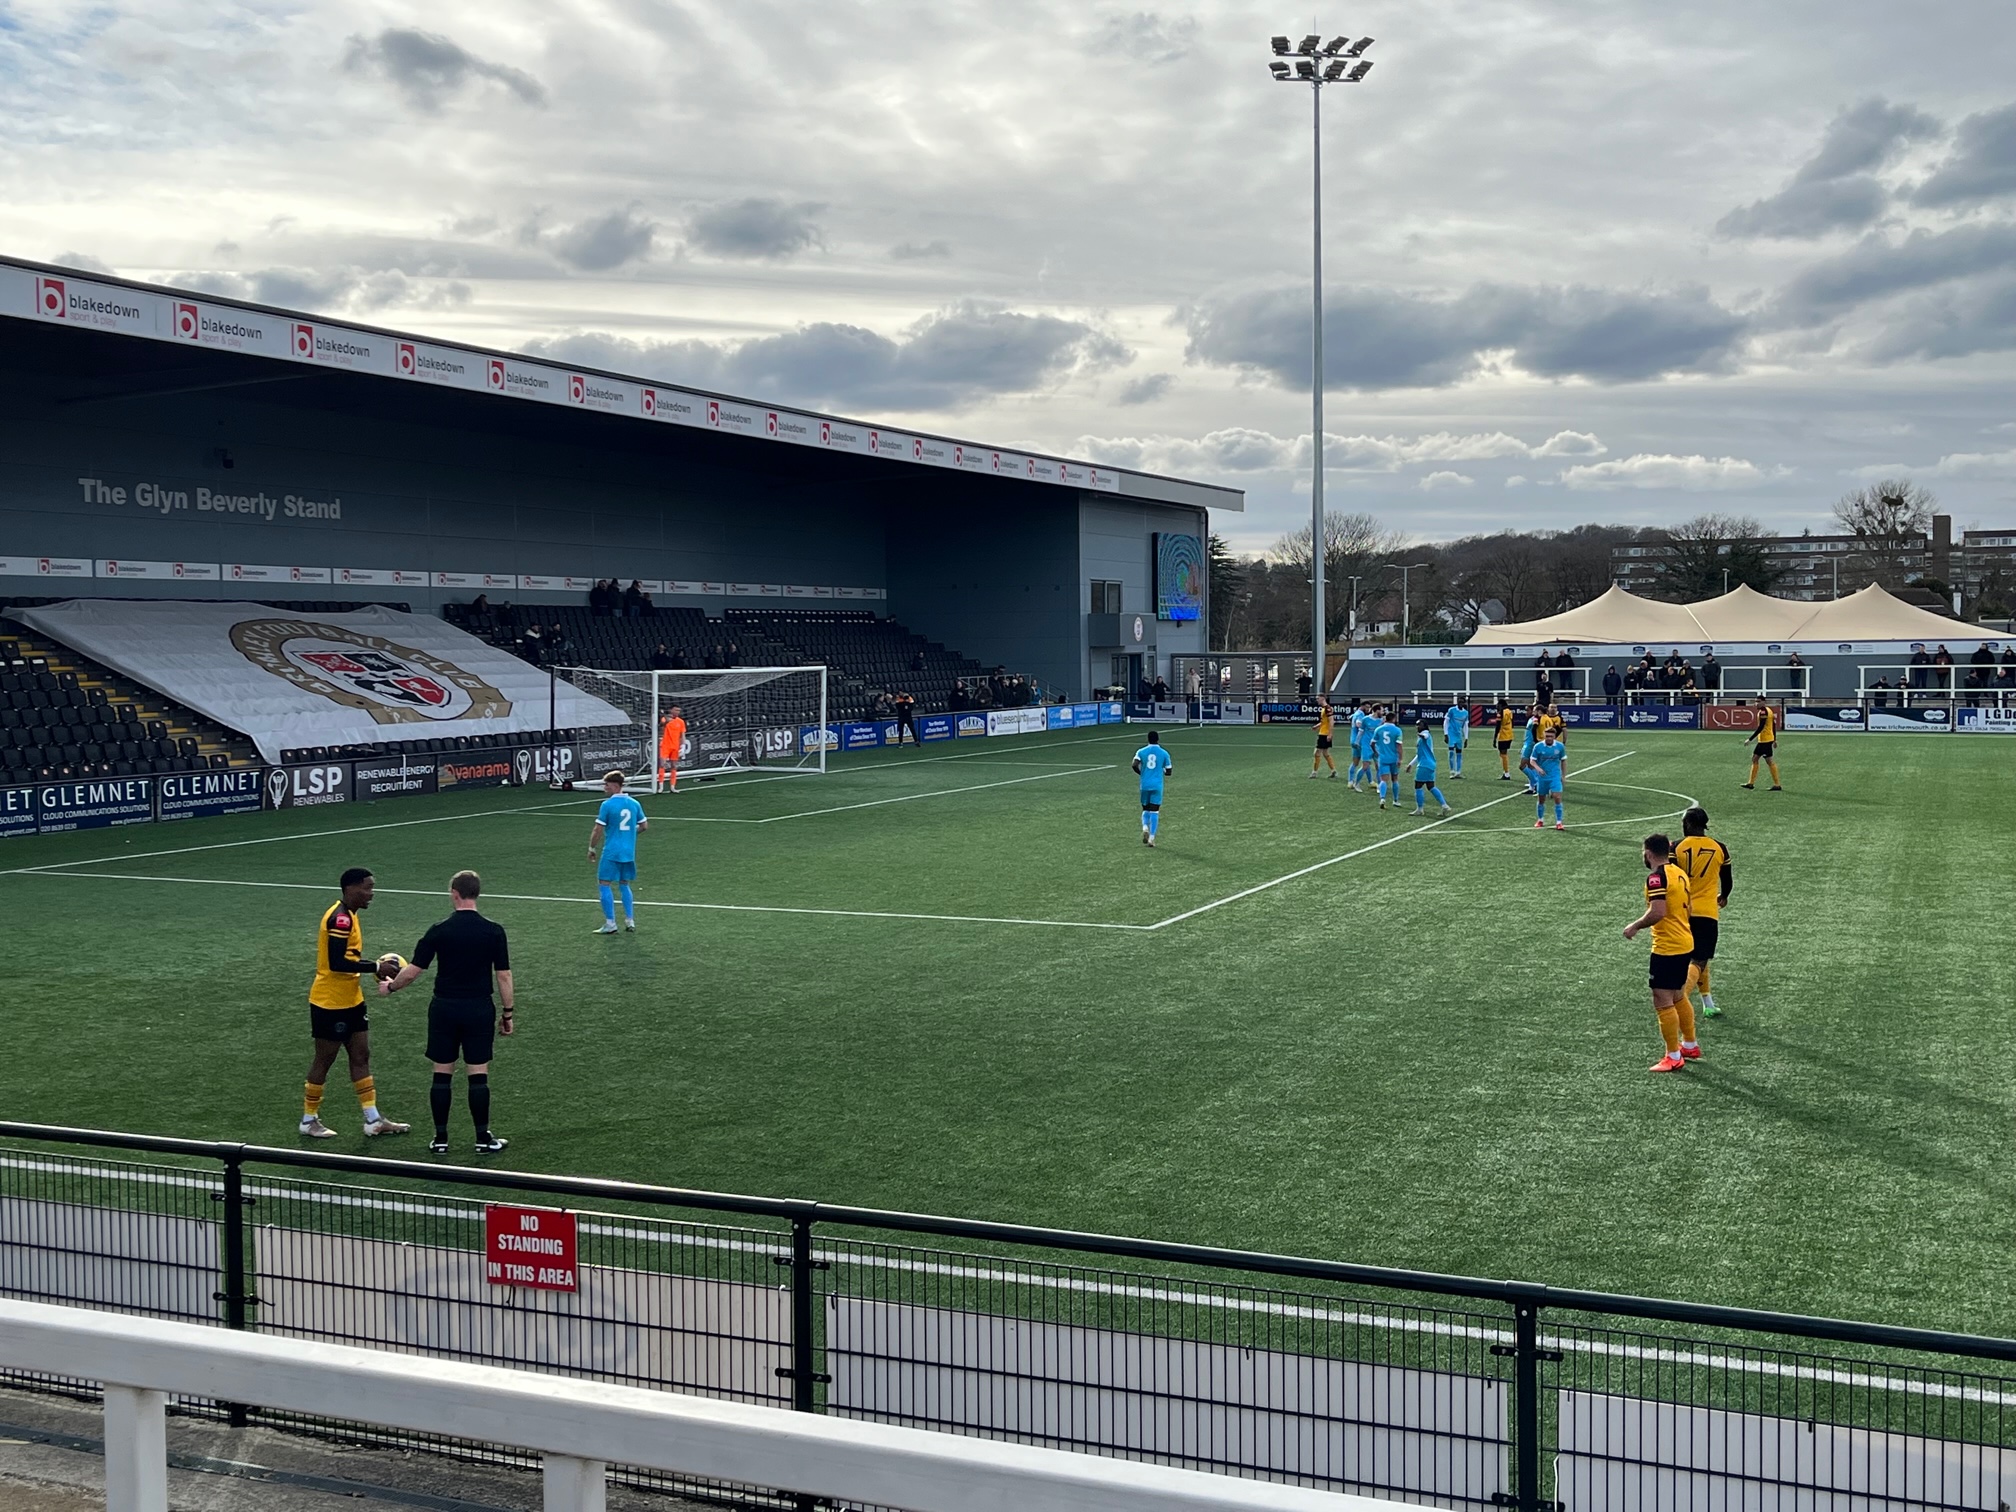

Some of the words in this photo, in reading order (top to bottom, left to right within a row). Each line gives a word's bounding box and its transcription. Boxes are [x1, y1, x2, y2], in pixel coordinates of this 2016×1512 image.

[70, 294, 140, 318] blakedown
[202, 317, 262, 340] blakedown
[316, 338, 370, 358] blakedown
[417, 355, 464, 374] blakedown
[506, 371, 549, 389] blakedown
[586, 386, 624, 402] blakedown
[657, 400, 691, 414] blakedown
[720, 411, 752, 424] blakedown
[779, 422, 806, 434] blakedown
[78, 478, 127, 505] The
[135, 482, 188, 514] Glyn
[196, 488, 277, 520] Beverly
[284, 495, 341, 520] Stand
[1262, 704, 1299, 712] RIBROX
[1985, 709, 1990, 719] L
[1994, 709, 2001, 719] G
[1712, 710, 1754, 727] QED
[700, 741, 729, 751] RENEWABL
[766, 730, 793, 751] LSP
[1383, 731, 1390, 744] 5
[535, 748, 572, 773] LSP
[583, 750, 618, 760] RENEWABLE
[1147, 754, 1156, 769] 8
[357, 766, 404, 780] RENEWABLE
[405, 764, 435, 778] ENERGY
[455, 762, 510, 780] vanarama
[593, 760, 632, 772] RECRUITMENT
[163, 772, 259, 798] GLEMNET
[293, 766, 343, 796] LSP
[42, 781, 148, 808] GLEMNET
[163, 800, 182, 810] CLOUD
[183, 796, 230, 808] COMMUNICATIONS
[231, 793, 259, 802] SOLUTIONS
[293, 793, 345, 807] RENEWABLES
[42, 812, 64, 820] CLOUD
[64, 806, 120, 818] COMMUNICATIONS
[120, 804, 150, 814] SOLUTIONS
[620, 809, 631, 830] 2
[1683, 847, 1716, 878] 17
[521, 1215, 539, 1231] NO
[498, 1234, 563, 1256] STANDING
[488, 1262, 501, 1278] IN
[505, 1264, 534, 1282] THIS
[538, 1268, 574, 1286] AREA
